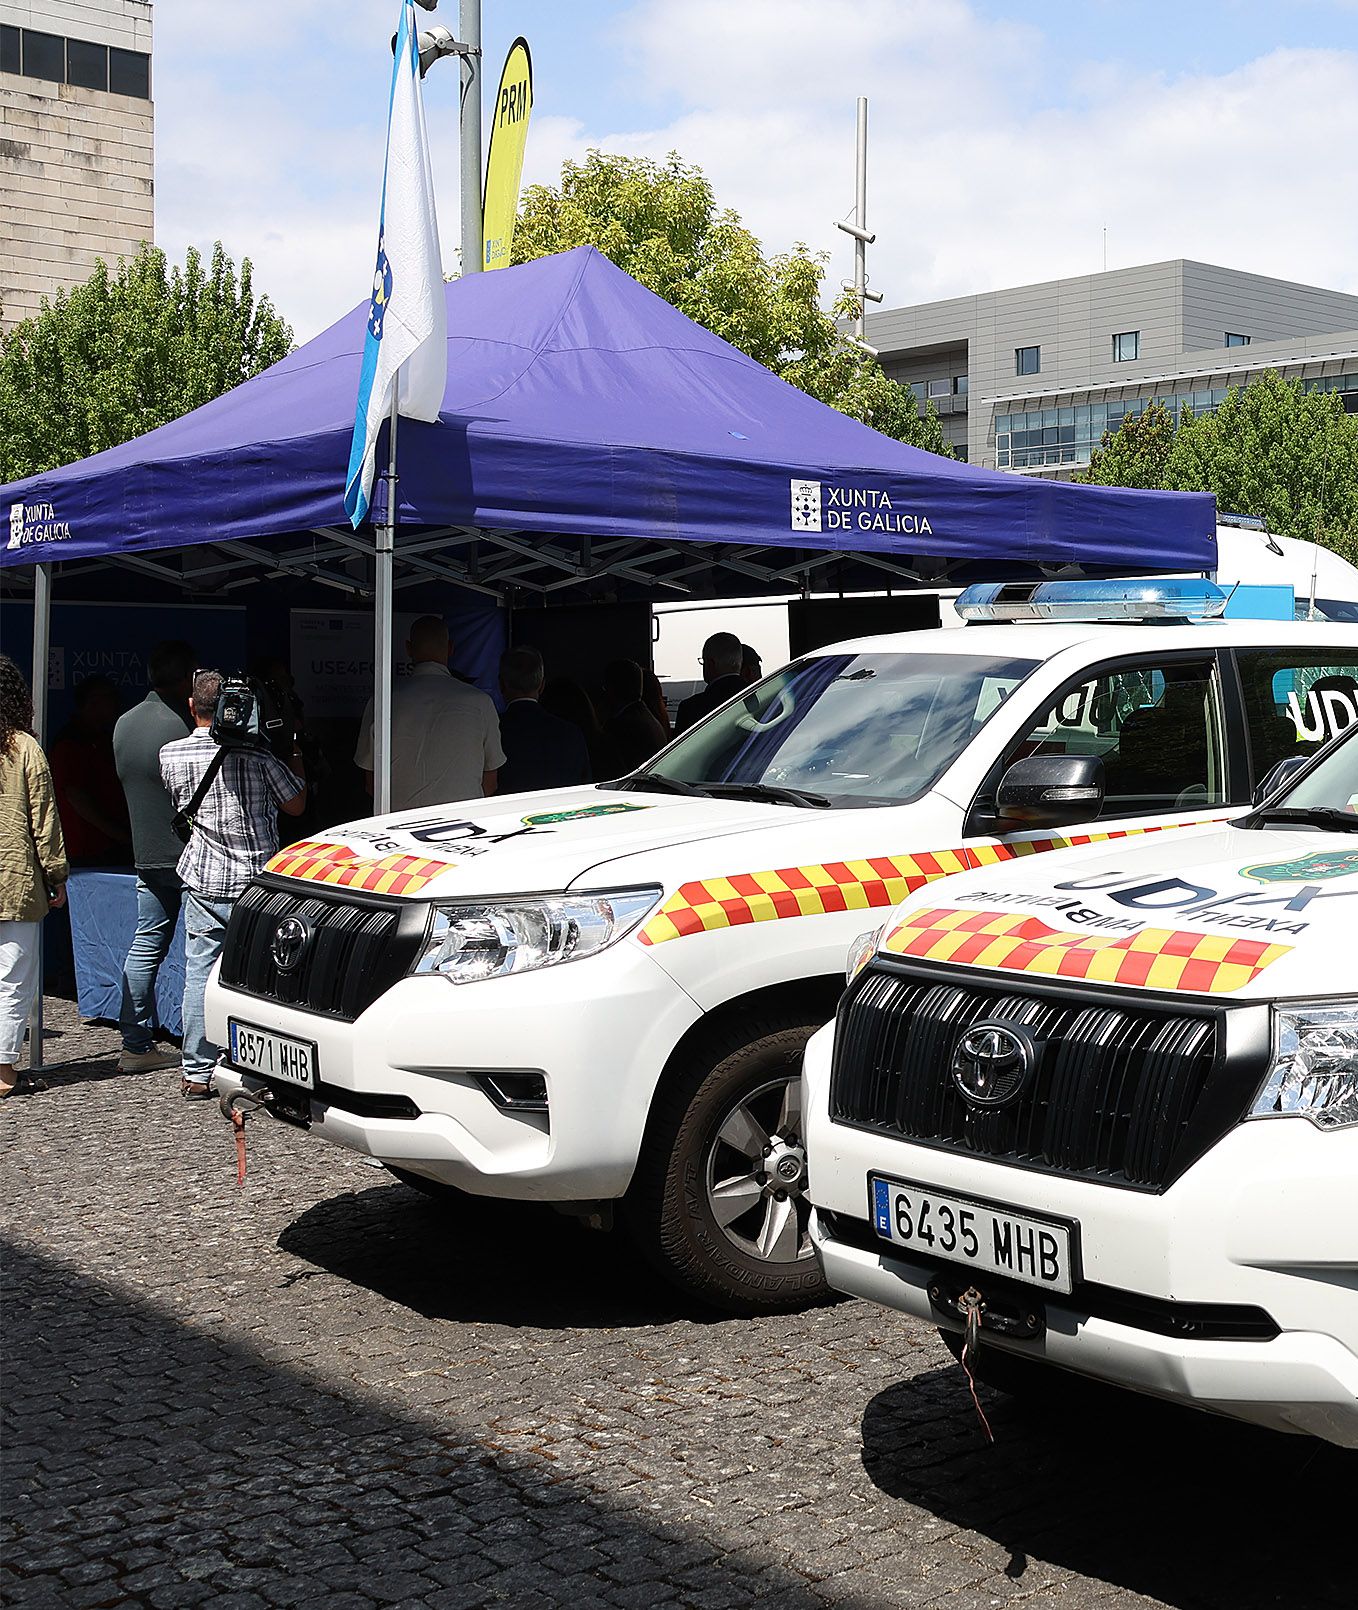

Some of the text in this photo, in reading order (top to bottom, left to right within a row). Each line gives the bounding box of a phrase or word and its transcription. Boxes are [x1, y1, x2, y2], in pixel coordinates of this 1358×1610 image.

[500, 80, 527, 128] PRM
[828, 487, 892, 509] XUNTA
[25, 504, 54, 523] XUNTA
[828, 510, 933, 534] DE GALICIA
[22, 523, 71, 543] DE GALICIA
[72, 651, 142, 667] XUNTA
[311, 660, 416, 676] USE4FES
[239, 1030, 274, 1071] 8571
[279, 1042, 309, 1082] MHB
[879, 1193, 1060, 1281] E 6435 MHB
[697, 1231, 827, 1292] OLANDAR
